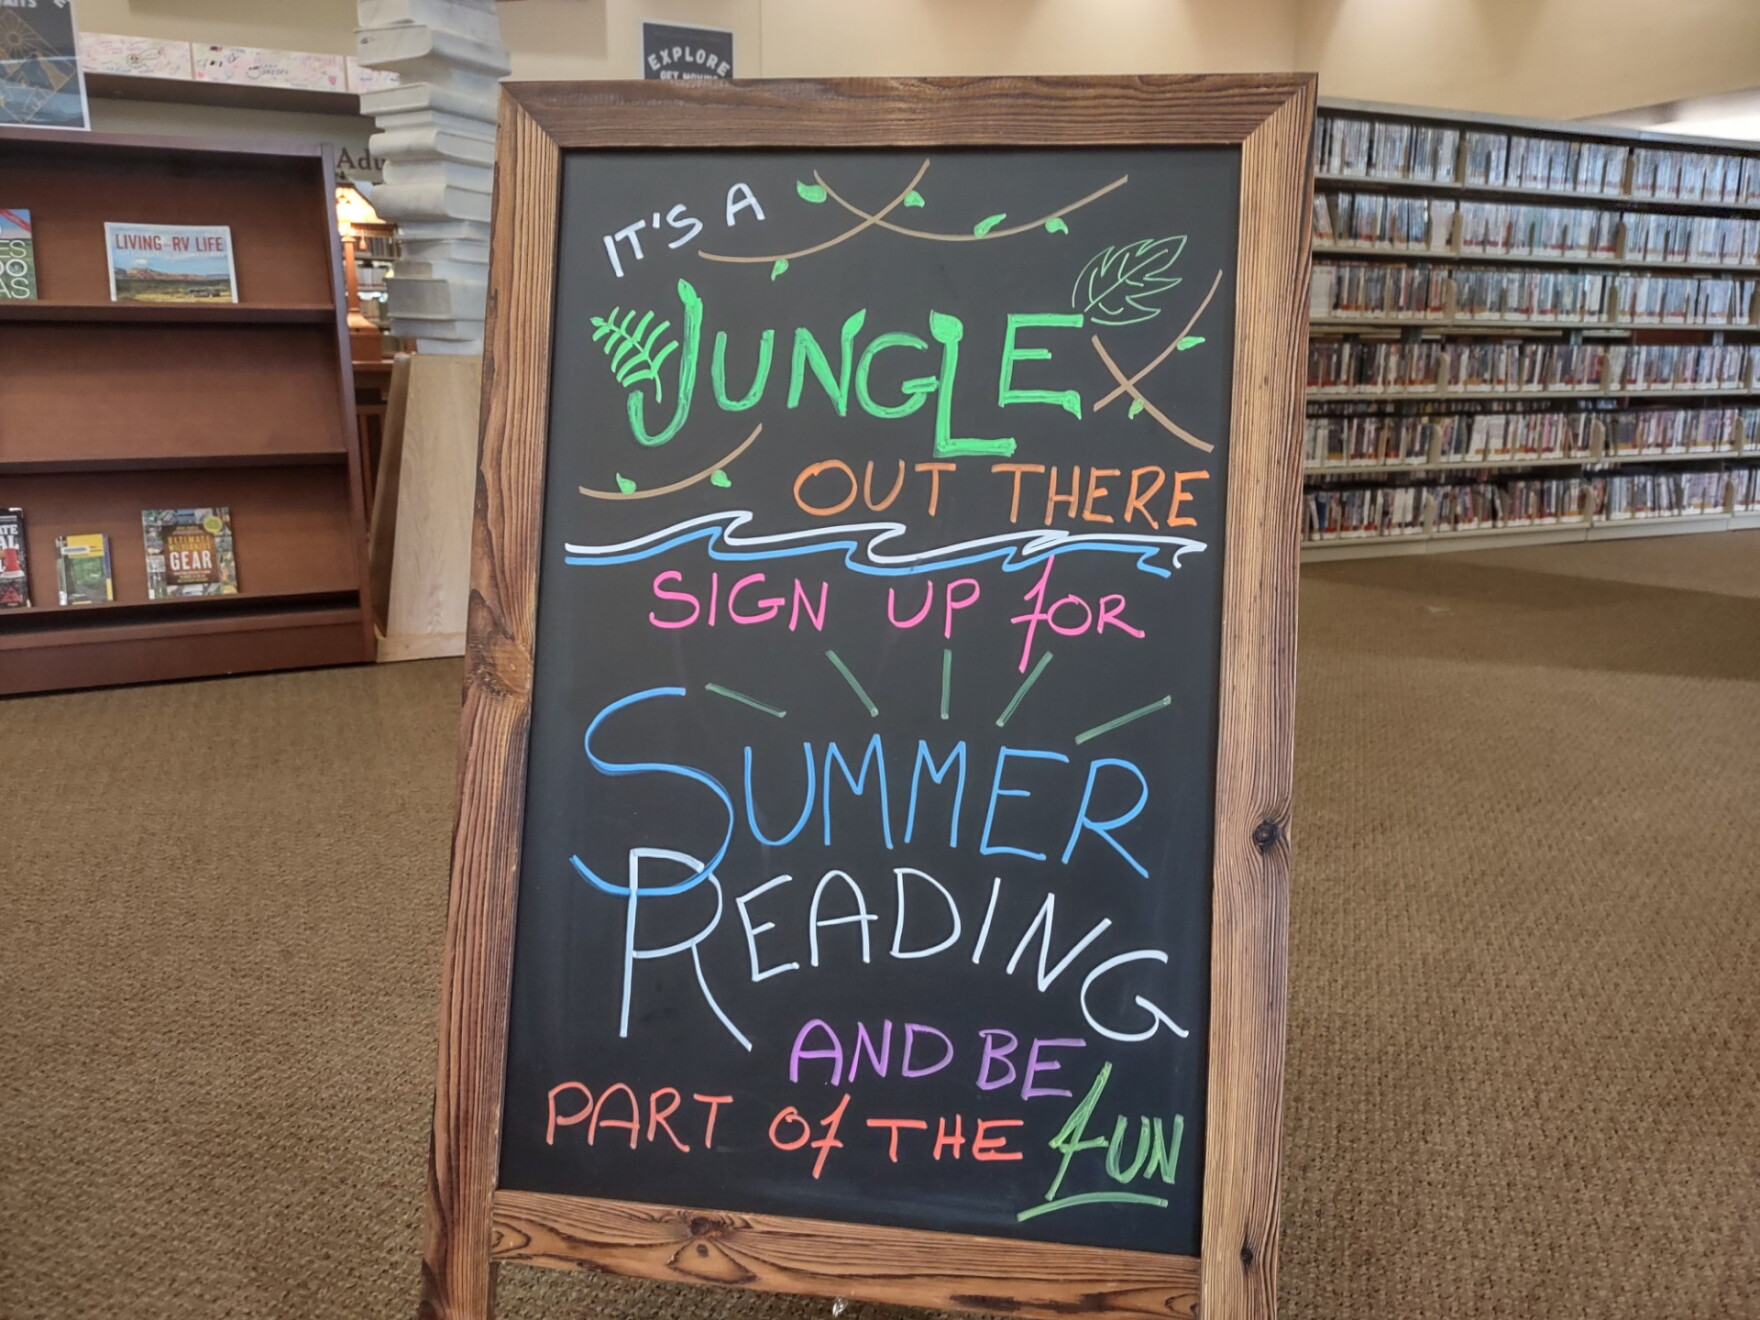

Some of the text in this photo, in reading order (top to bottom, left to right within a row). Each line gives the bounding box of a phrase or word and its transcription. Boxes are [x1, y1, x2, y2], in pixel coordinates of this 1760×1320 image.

[647, 46, 731, 77] EXPLORE
[115, 234, 225, 252] LIVING RV LIFE
[603, 182, 766, 277] IT'S A
[627, 278, 1084, 458] JUNGLE
[793, 459, 1210, 530] OUT THERE
[170, 550, 212, 571] GEAR
[648, 570, 828, 632] SIGN
[886, 578, 980, 639] UP
[569, 687, 1149, 896] SUMMER
[619, 847, 1189, 1052] READING
[789, 1019, 1086, 1100] AND BE
[545, 1082, 733, 1152] PART
[867, 1114, 1024, 1163] THE
